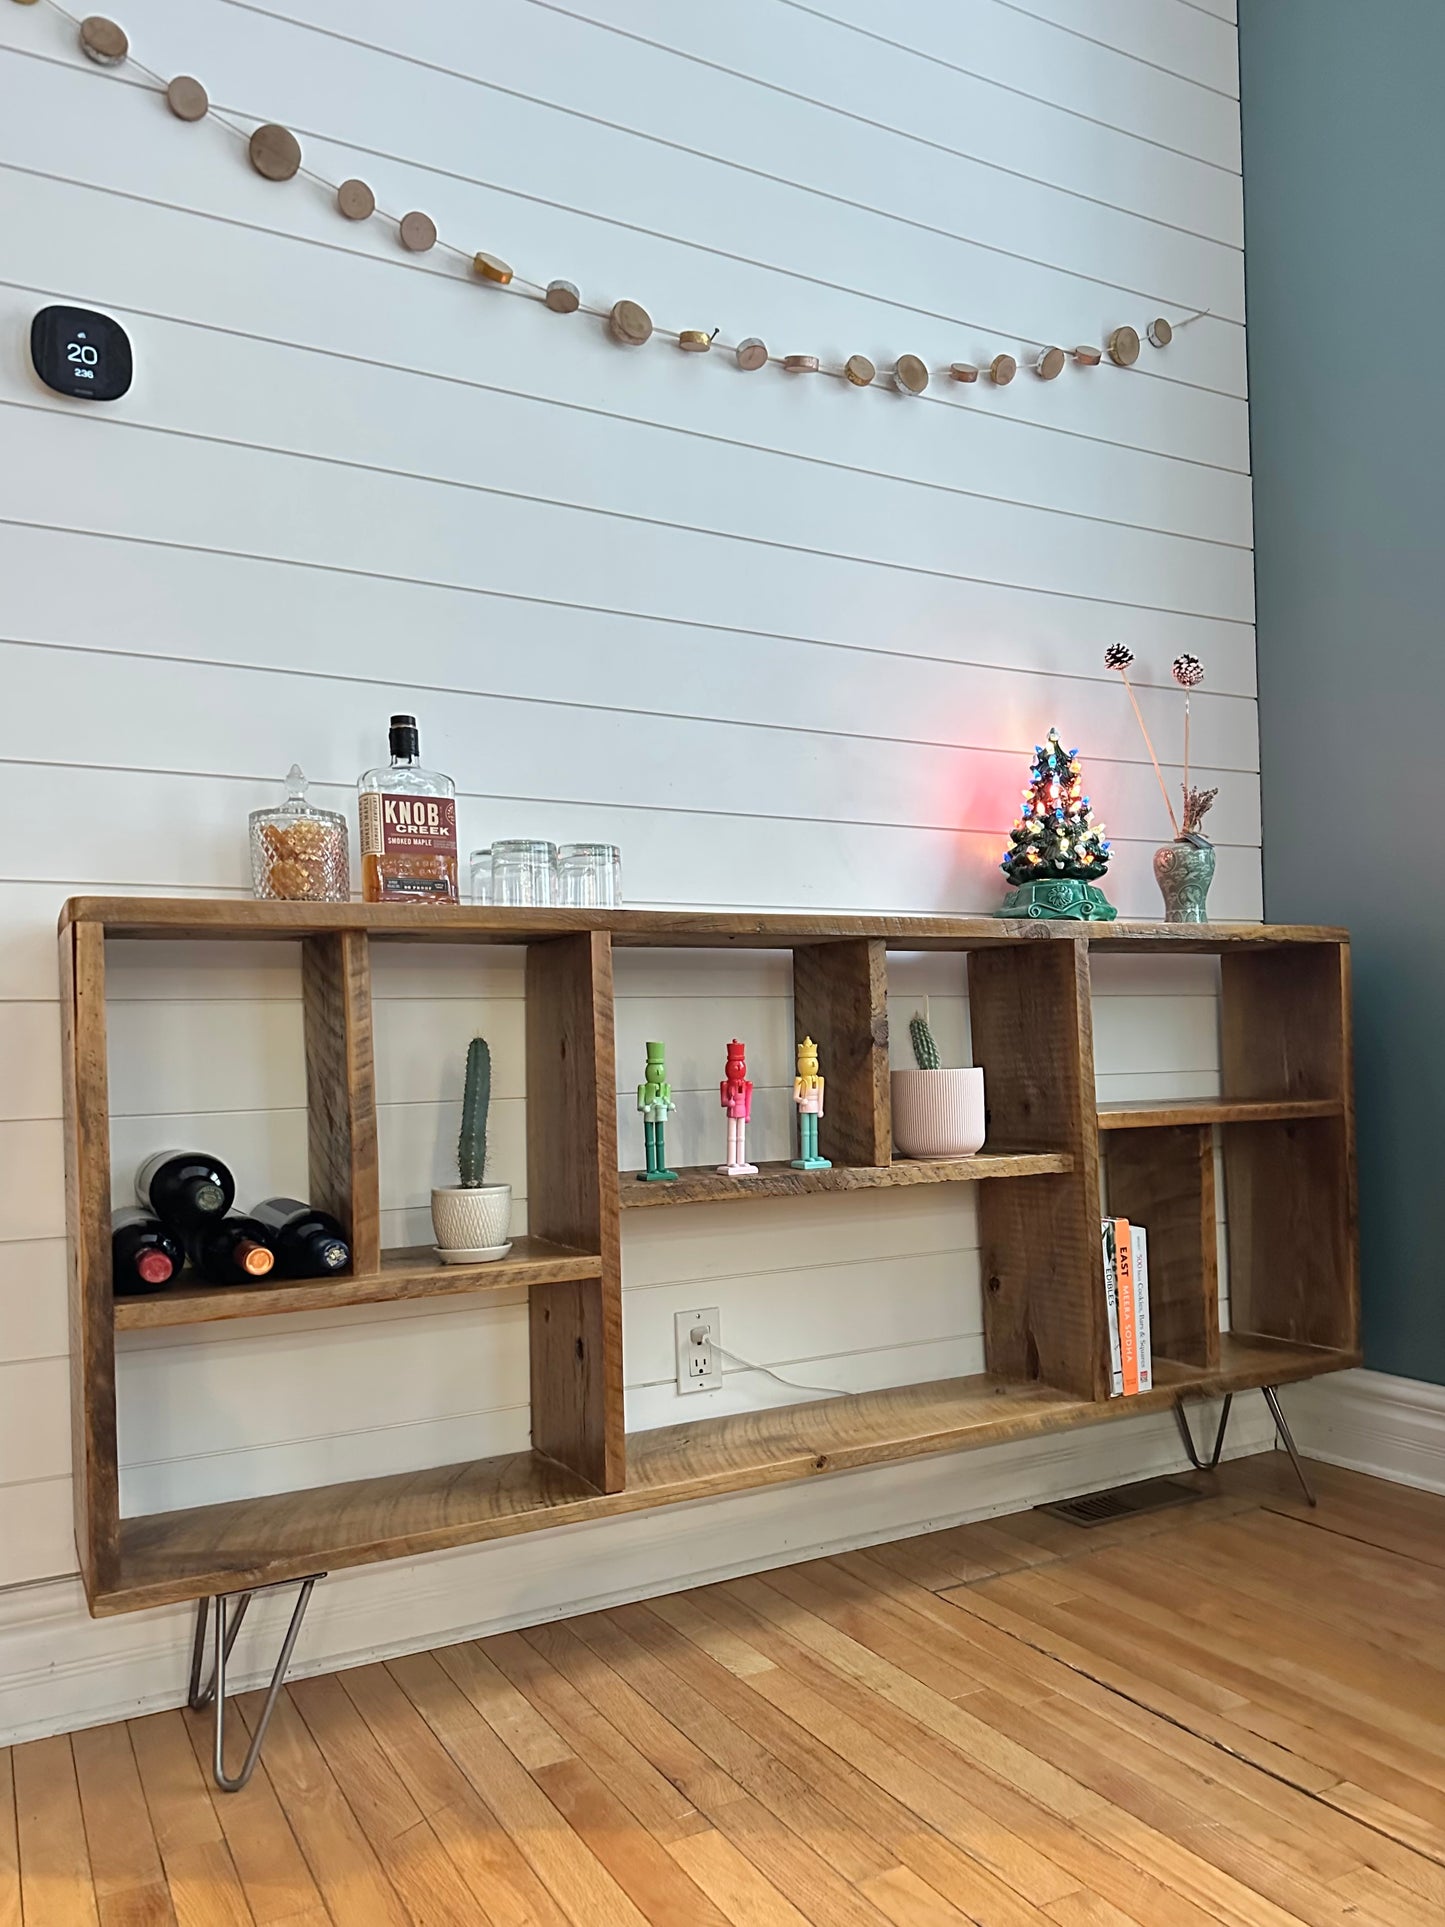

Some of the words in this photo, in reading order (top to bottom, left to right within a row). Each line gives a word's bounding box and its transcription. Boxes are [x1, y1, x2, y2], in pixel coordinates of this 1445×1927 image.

[67, 343, 98, 365] 20
[384, 800, 439, 826] KNOB
[388, 837, 412, 845] SMOKED
[413, 838, 432, 847] MAPLE
[395, 825, 450, 836] CREEK
[1120, 1247, 1129, 1277] EAST
[1106, 1269, 1115, 1306] EDIBLES
[1122, 1285, 1131, 1320] MEERA
[1125, 1324, 1133, 1363] SODHA
